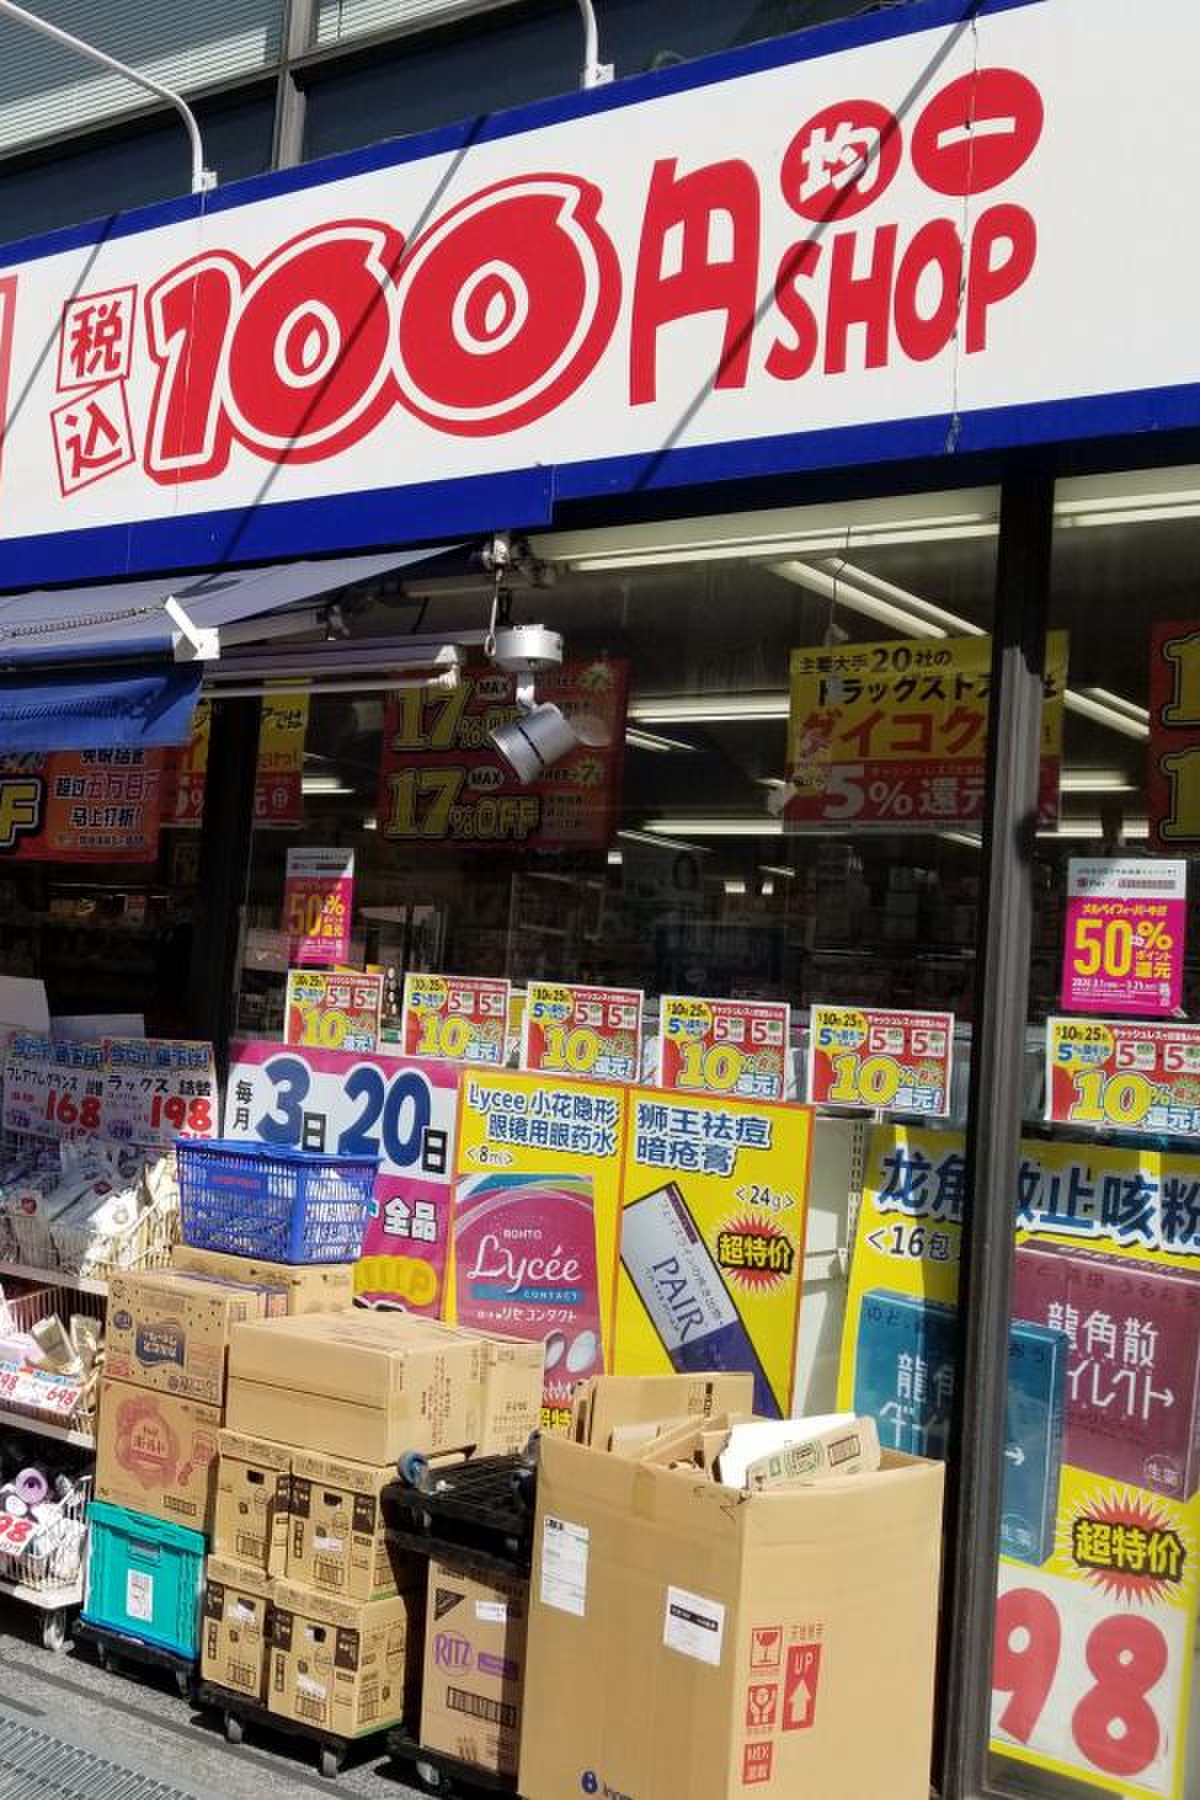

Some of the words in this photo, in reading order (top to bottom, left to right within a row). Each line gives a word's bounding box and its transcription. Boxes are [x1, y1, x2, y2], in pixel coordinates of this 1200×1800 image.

[800, 112, 1017, 200] 均一
[764, 204, 1038, 383] SHOP
[68, 300, 128, 478] 税込
[1073, 918, 1174, 977] 50%
[107, 1074, 169, 1094] ラックス
[234, 1078, 253, 1132] 毎月
[468, 1084, 526, 1112] Lycee
[46, 1088, 102, 1130] 168
[150, 1091, 213, 1131] 198
[636, 1102, 773, 1148] 狮王祛痘
[488, 1114, 618, 1158] 眼镜用眼药水
[636, 1135, 737, 1177] 暗疮膏
[383, 1196, 438, 1243] 全品
[503, 1229, 543, 1240] ROHTO
[466, 1233, 583, 1294] Lycée
[717, 1231, 795, 1276] 超特价
[653, 1256, 706, 1342] PAIR
[1047, 1300, 1160, 1370] 龍角散
[1074, 1519, 1186, 1582] 超特价
[434, 1632, 474, 1667] RITZ
[793, 1650, 814, 1676] UP
